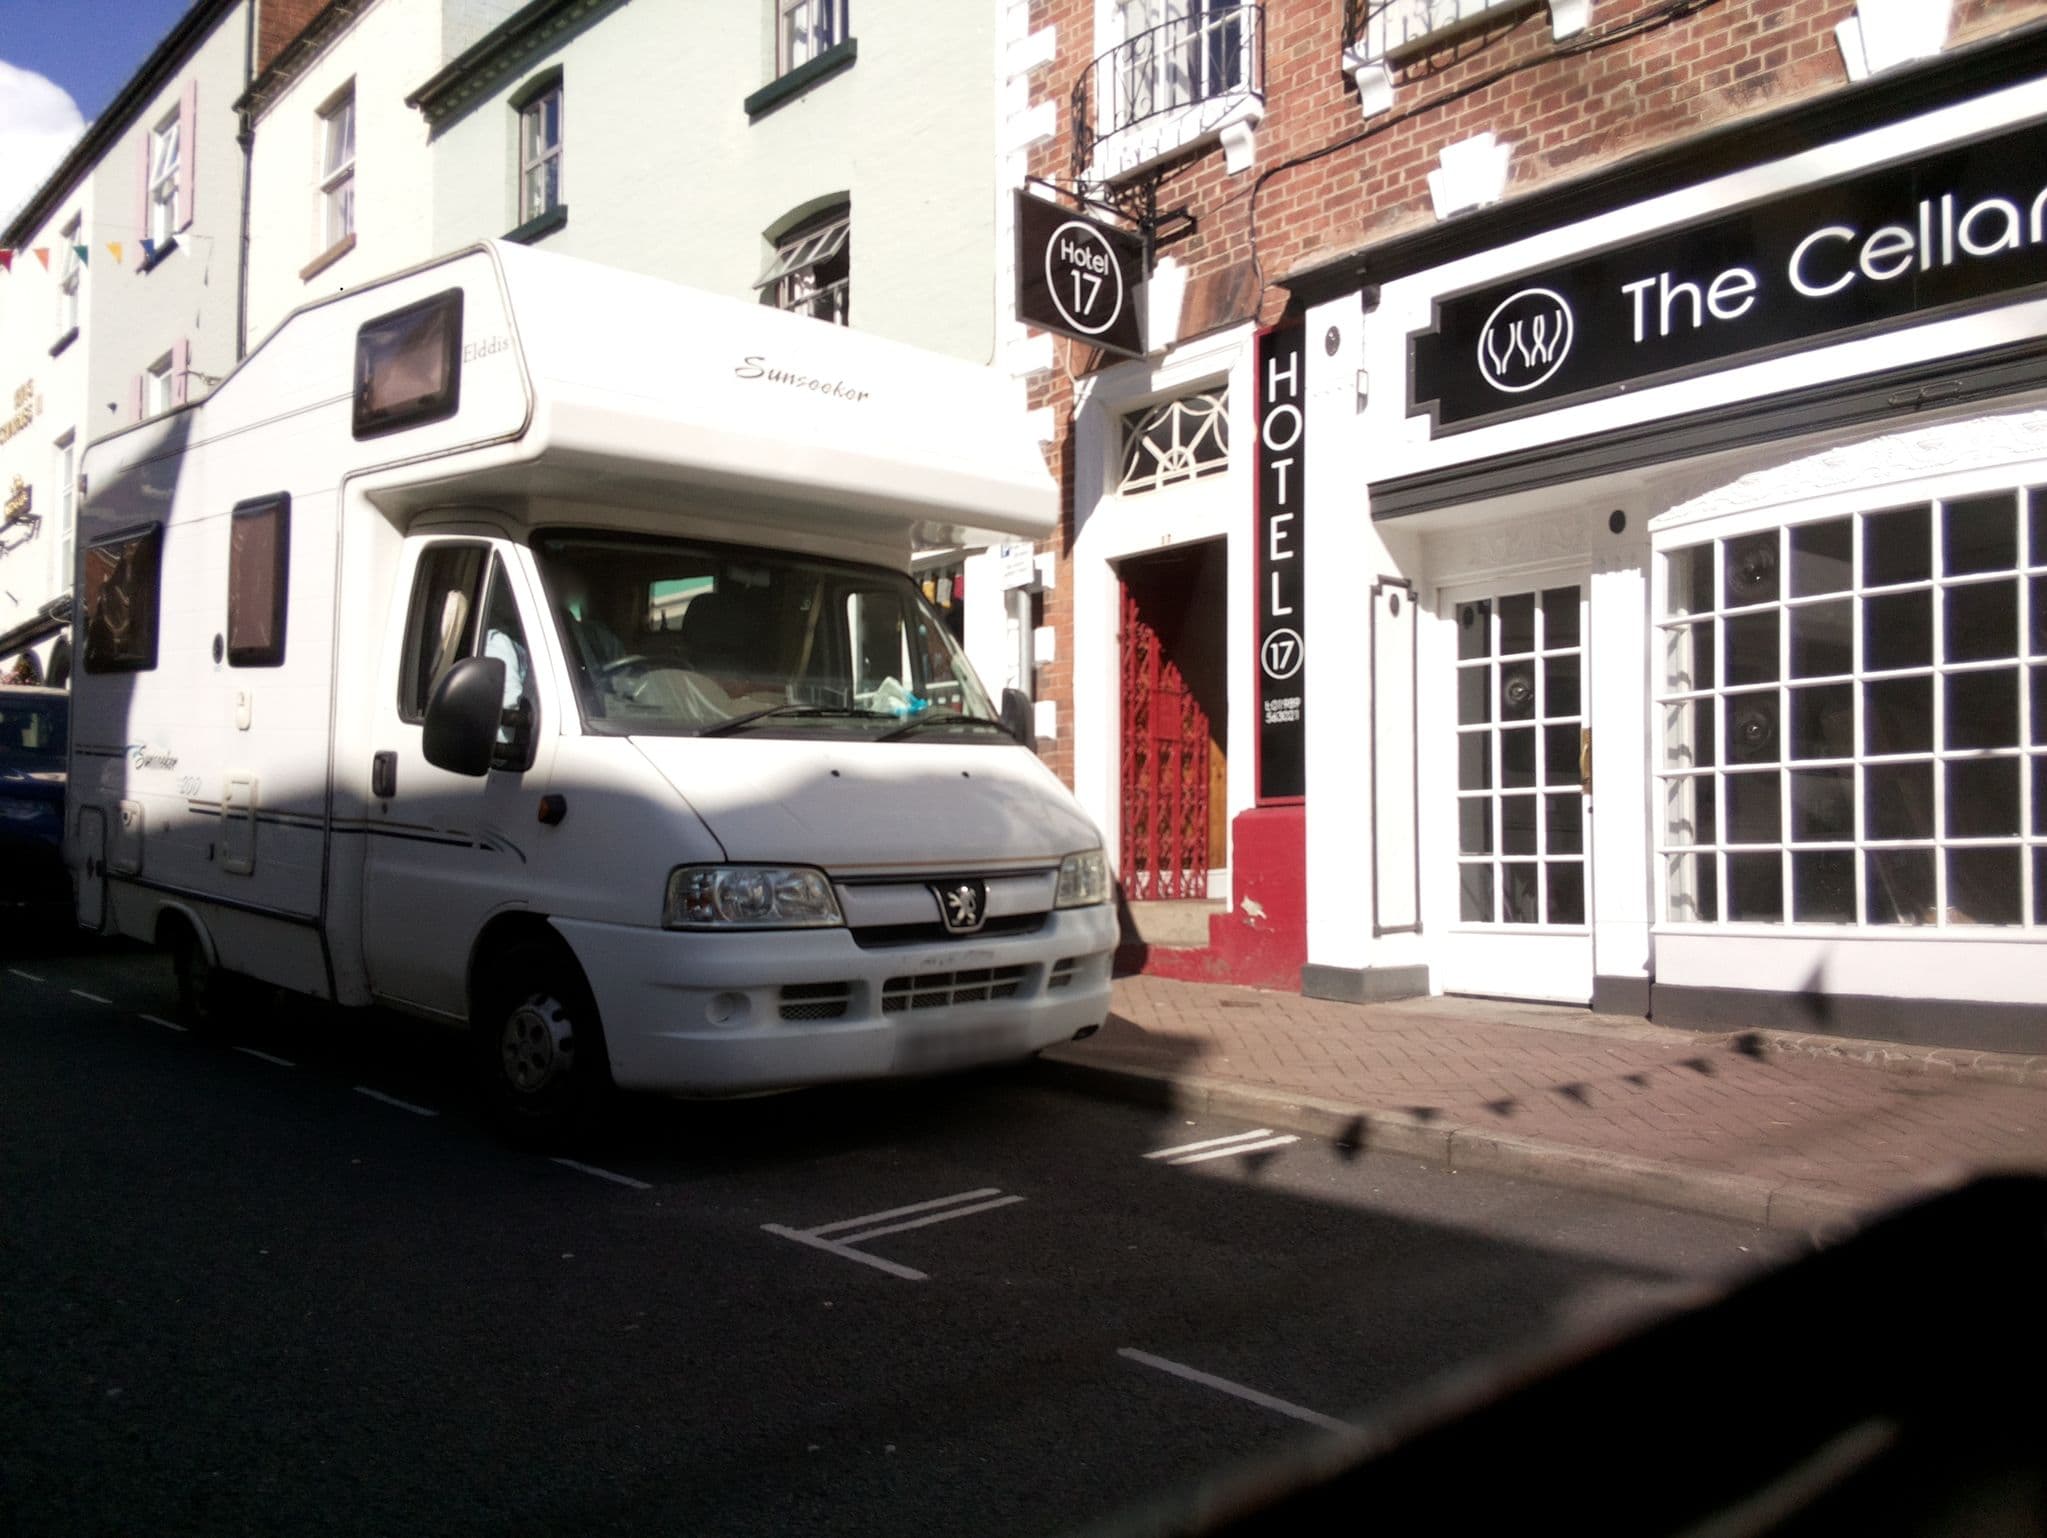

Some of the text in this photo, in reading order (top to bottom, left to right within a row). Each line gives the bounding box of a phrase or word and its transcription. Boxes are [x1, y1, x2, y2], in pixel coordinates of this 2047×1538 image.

[1061, 237, 1109, 274] Hotel
[1070, 269, 1103, 316] 17
[1621, 267, 1757, 343] The
[464, 336, 509, 363] Elddis
[734, 356, 869, 402] Sunseeker
[1262, 351, 1304, 616] HOTEL
[1269, 640, 1295, 670] 17
